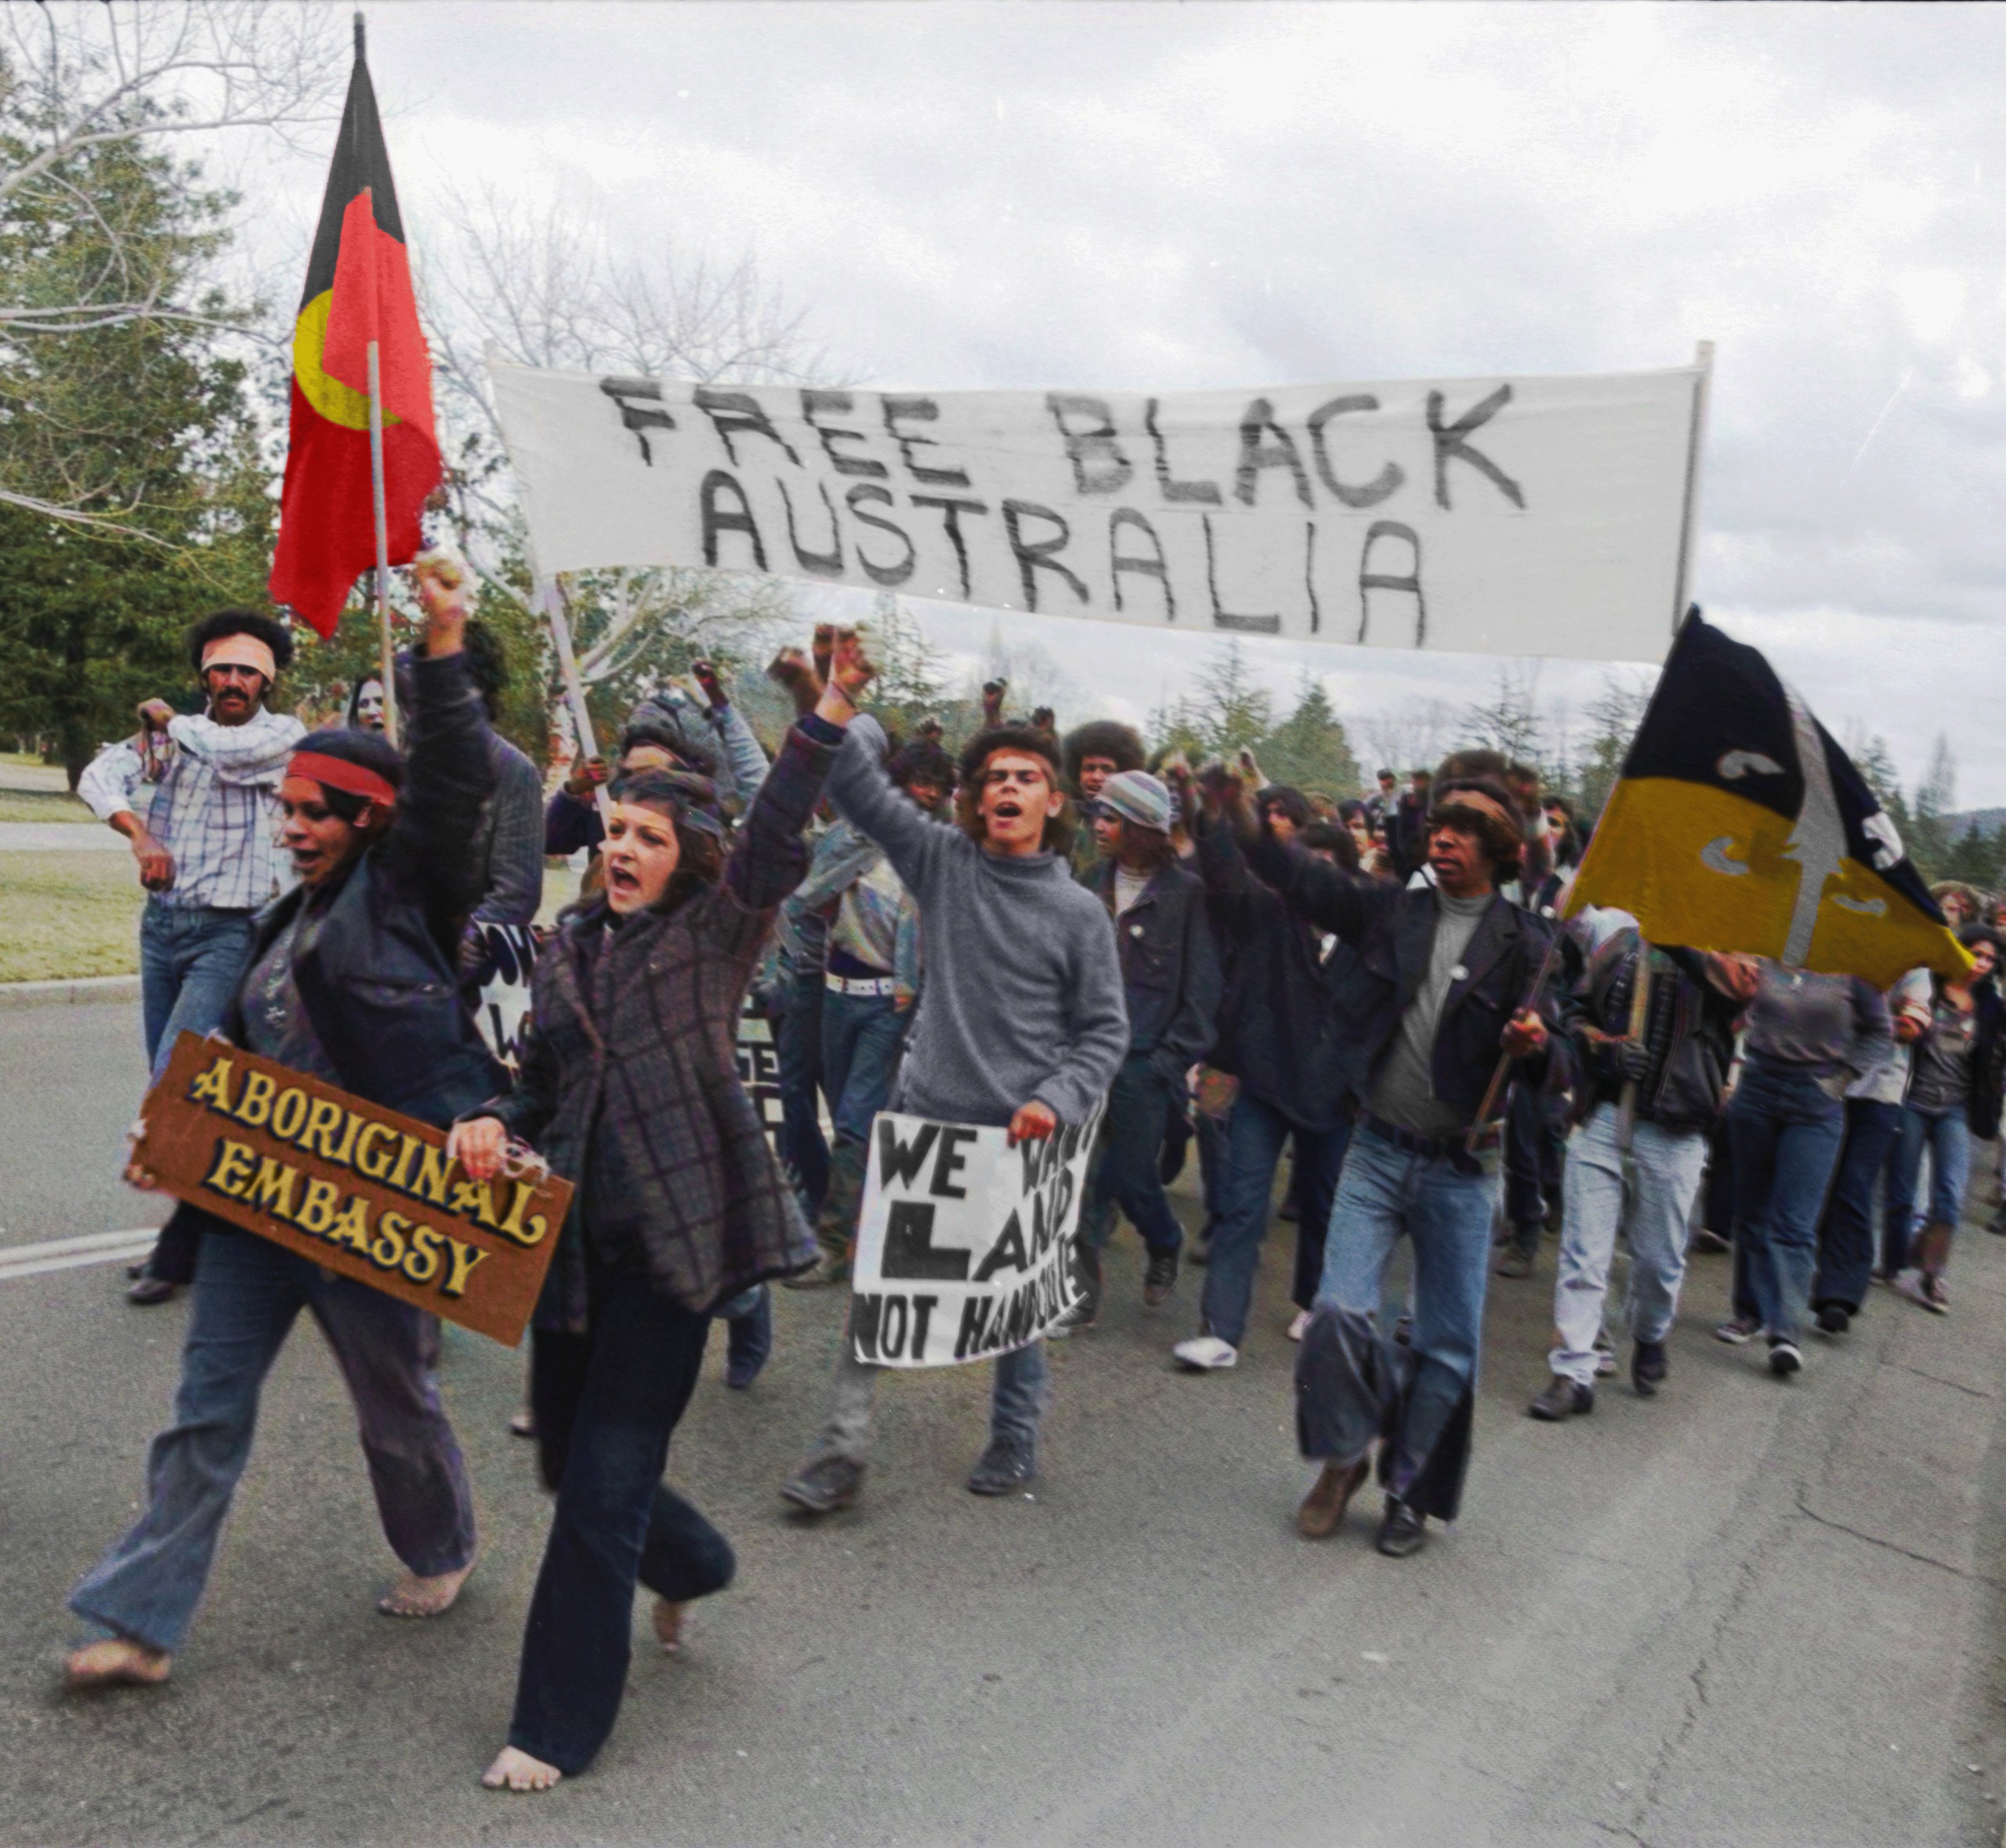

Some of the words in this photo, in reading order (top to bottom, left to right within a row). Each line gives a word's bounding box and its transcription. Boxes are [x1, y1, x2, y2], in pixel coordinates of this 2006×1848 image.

[600, 378, 970, 487] FREE
[1046, 383, 1526, 511] BLACK
[700, 470, 1425, 647] AUSTRALIA
[187, 1058, 548, 1249] ABORIGINAL
[203, 1137, 491, 1298] EMBASSY
[878, 1119, 978, 1199] WE
[880, 1166, 1074, 1282] LAND
[850, 1293, 938, 1360] NOT
